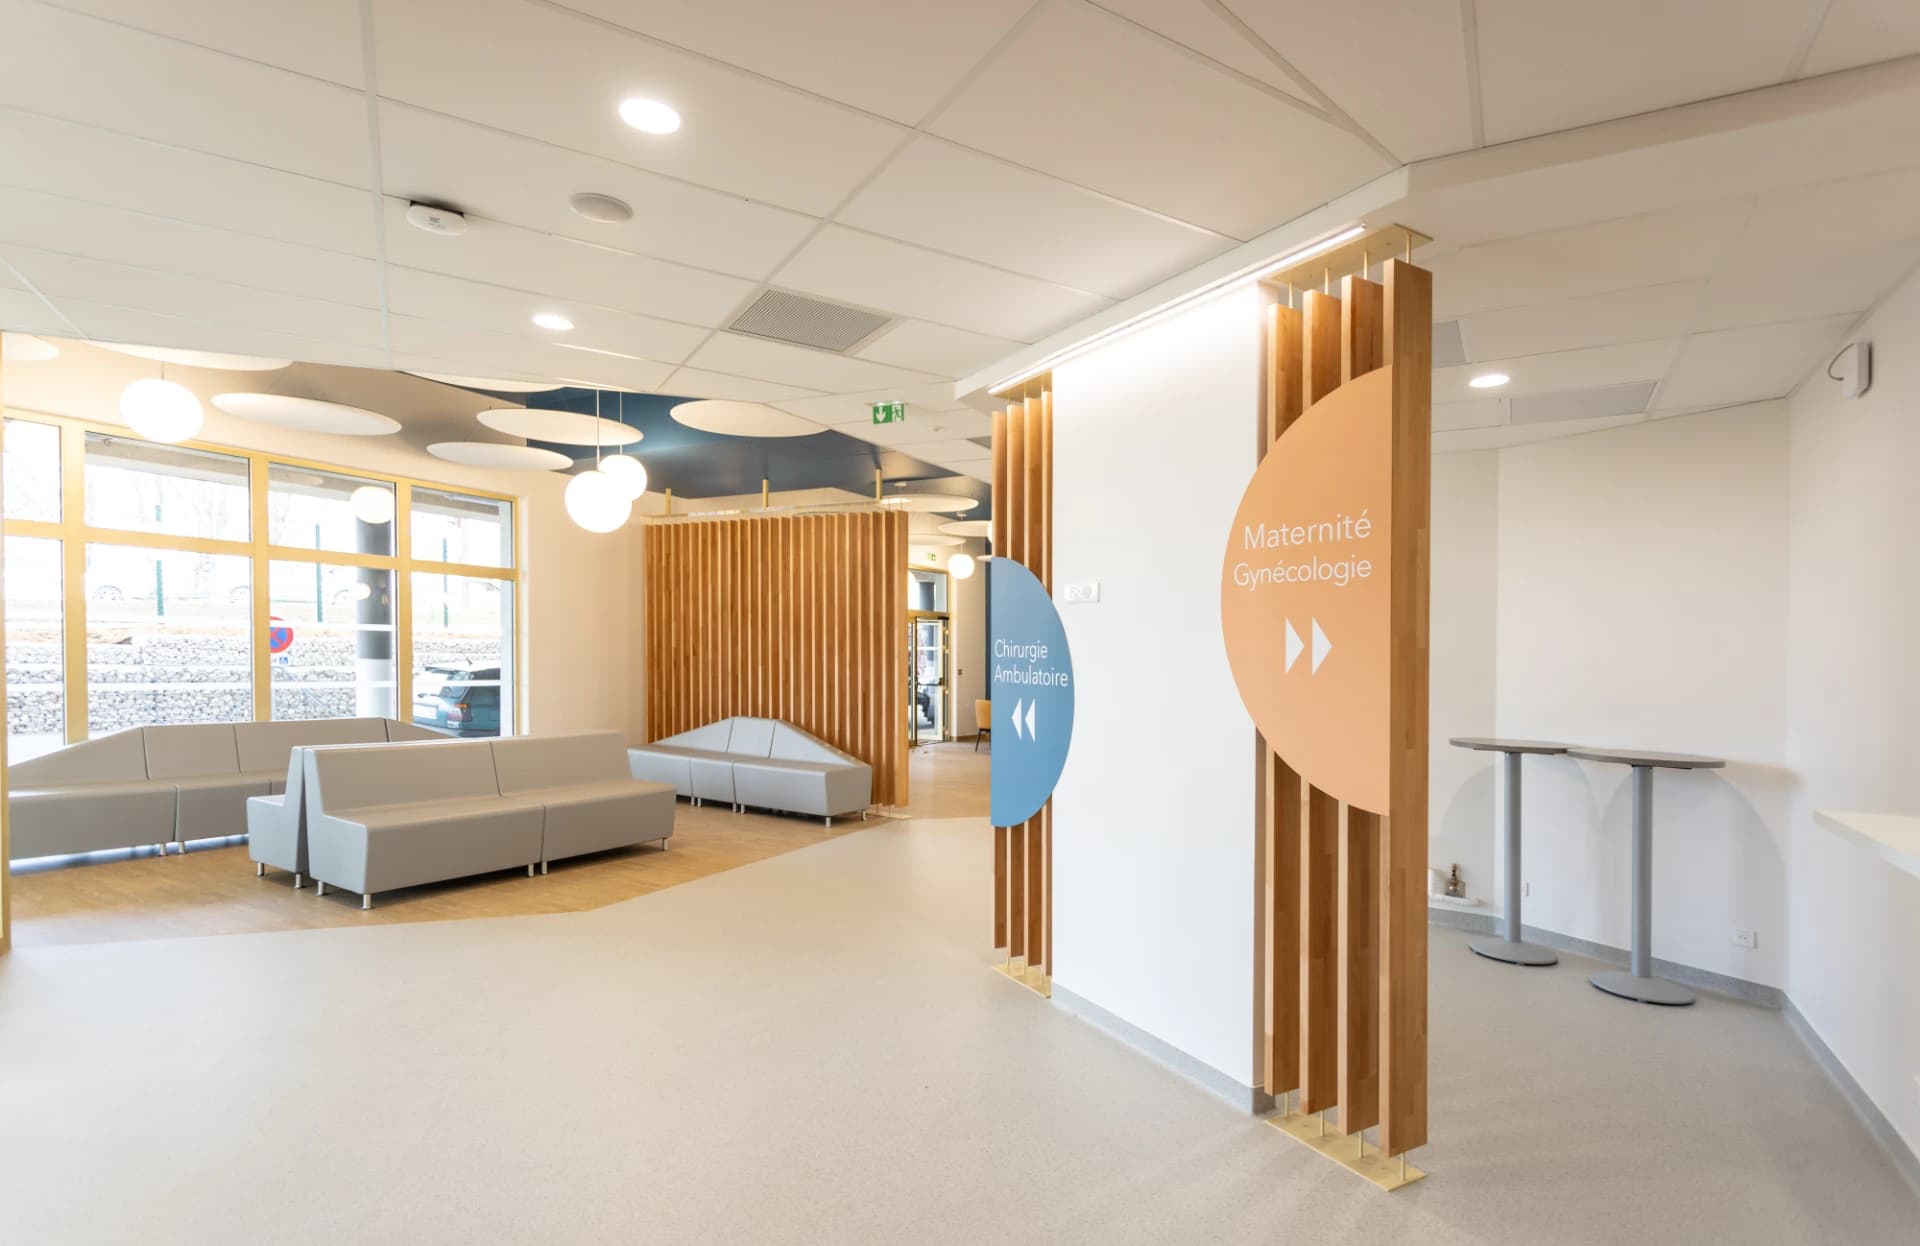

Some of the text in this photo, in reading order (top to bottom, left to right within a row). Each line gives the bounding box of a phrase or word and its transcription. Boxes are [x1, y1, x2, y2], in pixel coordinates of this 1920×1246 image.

[1244, 509, 1371, 550] Maternité
[1233, 555, 1371, 592] Gynécologie
[994, 640, 1048, 662] Chirurgie
[994, 664, 1069, 687] Ambulatoire
